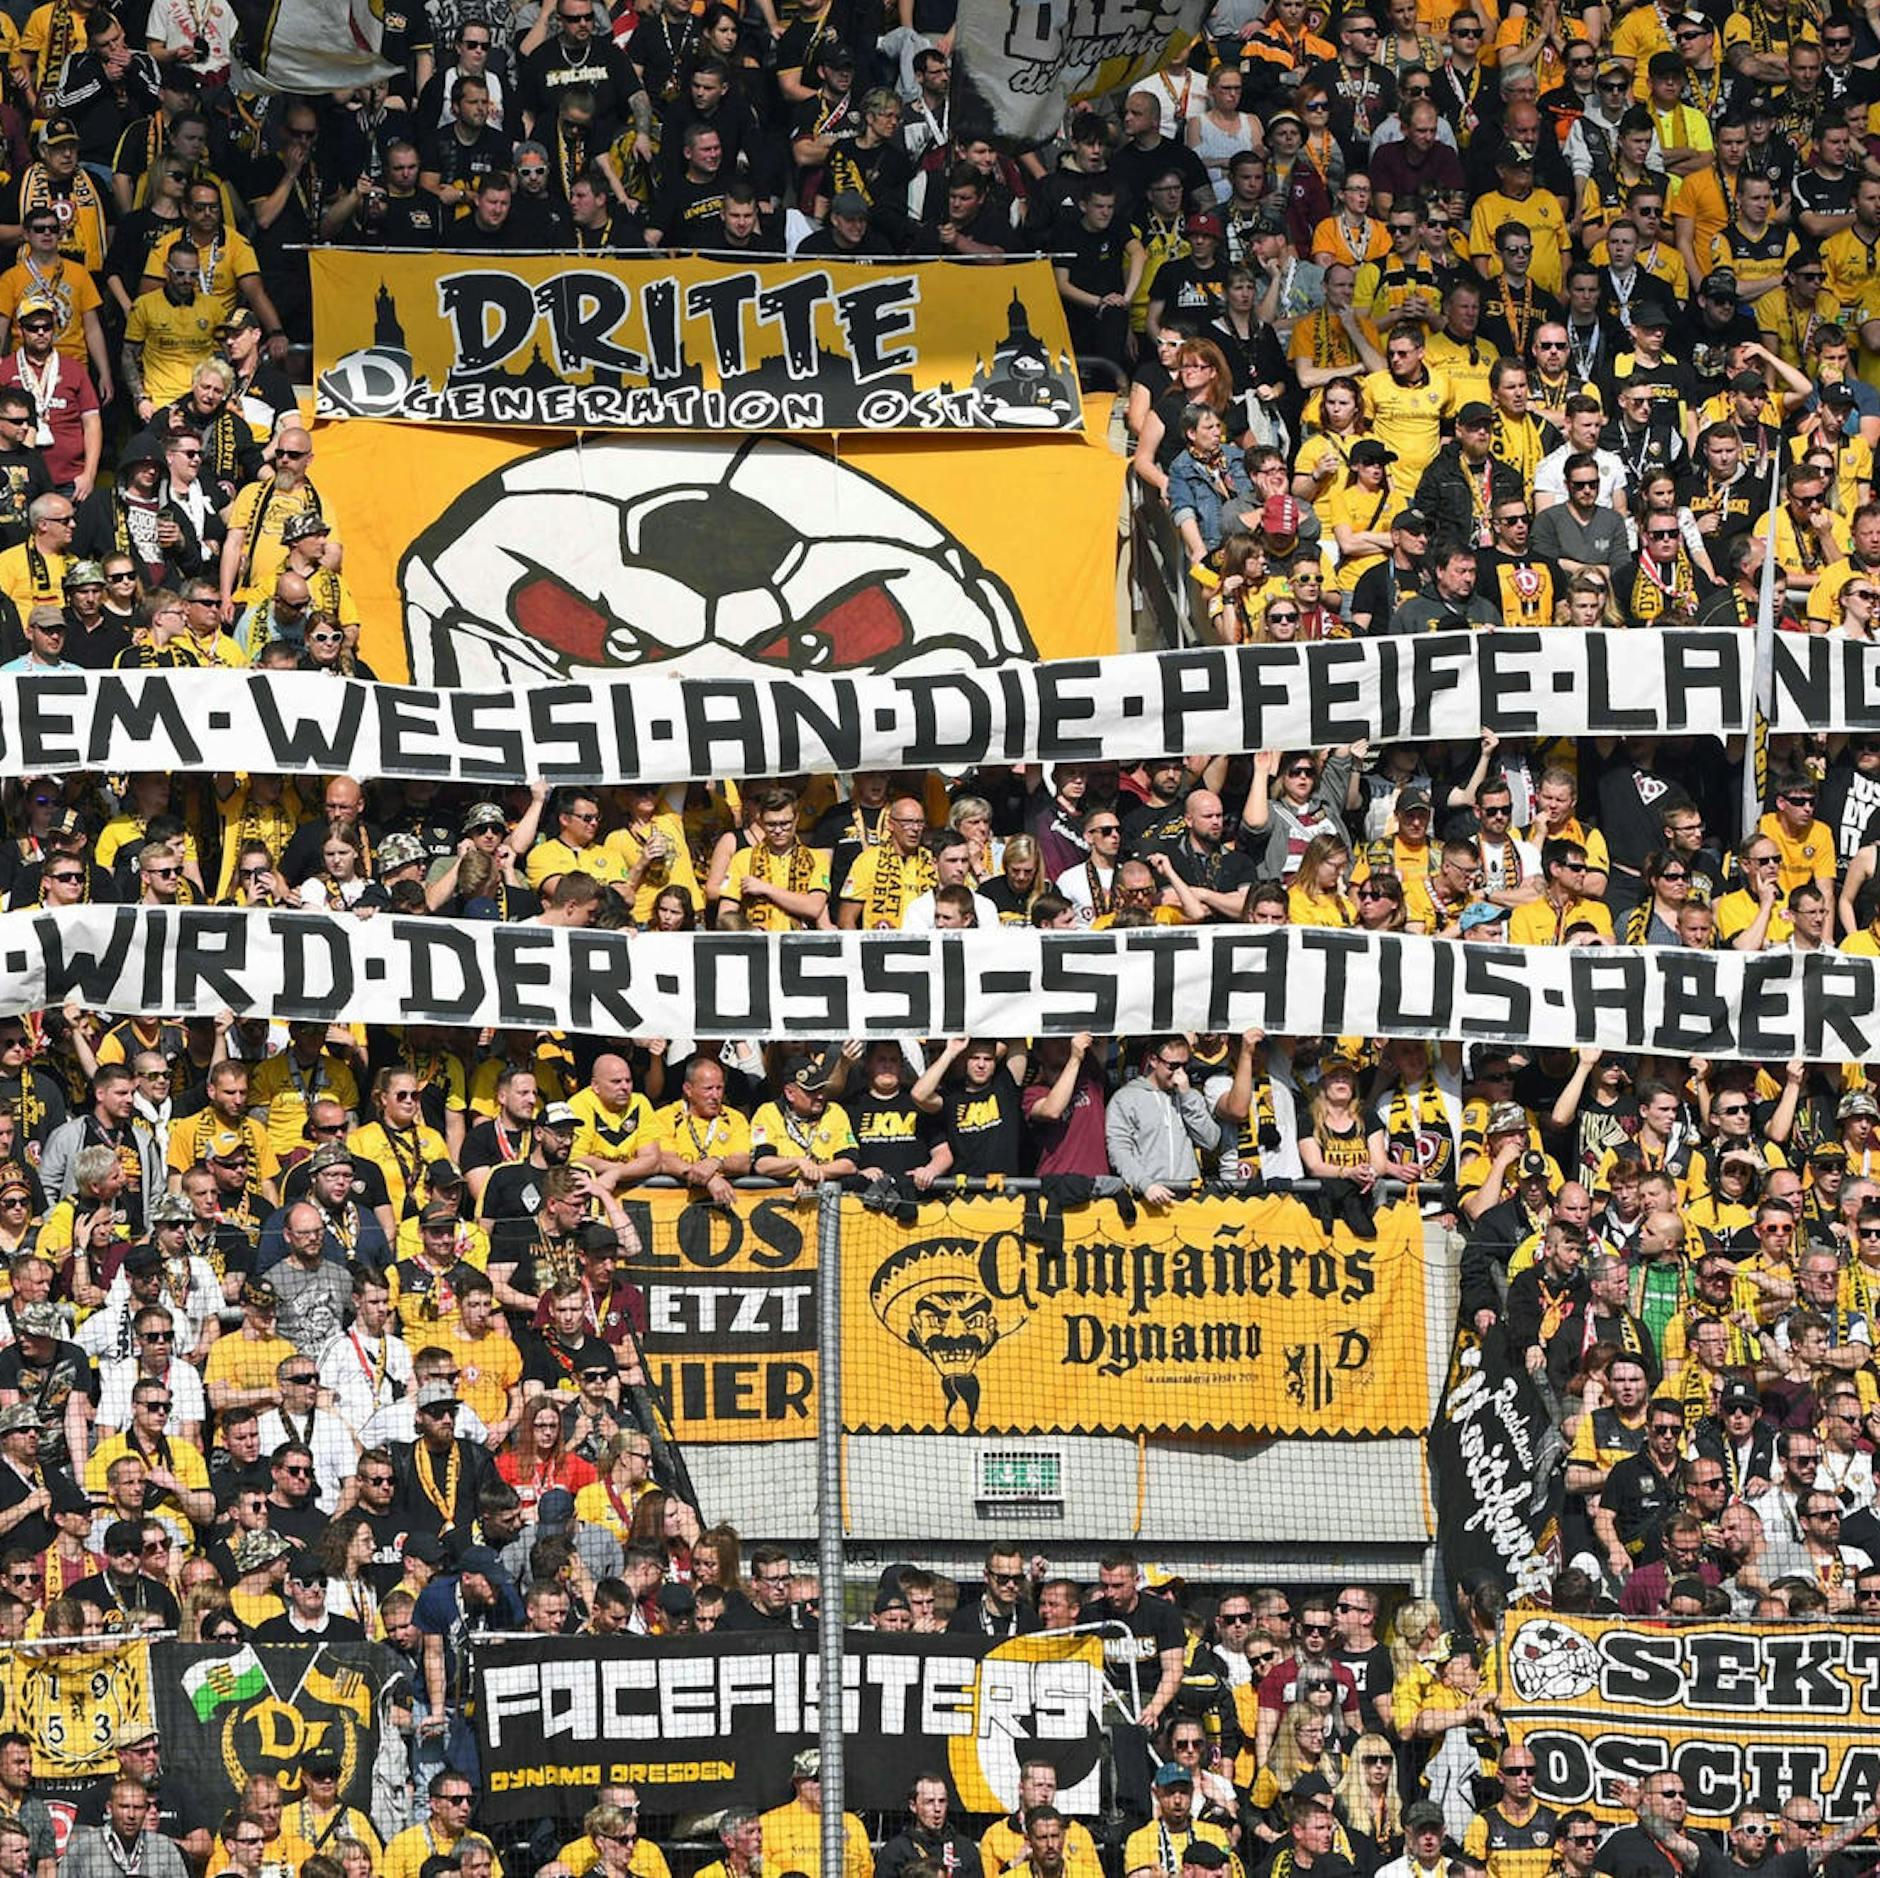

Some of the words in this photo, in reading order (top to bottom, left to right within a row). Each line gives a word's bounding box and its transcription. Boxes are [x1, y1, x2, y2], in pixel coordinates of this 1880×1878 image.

[436, 268, 921, 385] DRITTE
[403, 385, 824, 428] GENERATION
[856, 388, 985, 428] OST
[0, 676, 203, 769] EM
[248, 674, 640, 782] WESSI
[682, 678, 861, 776] AN
[894, 661, 1103, 765] DIE
[1160, 632, 1542, 753] PFEIFE
[33, 907, 354, 1017] WIRD
[392, 920, 643, 1032] DER
[1569, 944, 1875, 1059] ABER
[622, 1197, 804, 1268] LOS
[978, 1225, 1377, 1317] Compañeros
[634, 1284, 812, 1334] ETZT
[1061, 1313, 1263, 1376] Dynamo
[48, 1673, 60, 1700] 1
[91, 1672, 110, 1699] 9
[484, 1652, 1091, 1749] FACEFISTERS
[48, 1714, 66, 1744] 5
[92, 1712, 112, 1744] 3
[490, 1764, 601, 1793] DYNAMO
[609, 1760, 736, 1784] DRESDEN
[1523, 1729, 1880, 1825] OSCHA
